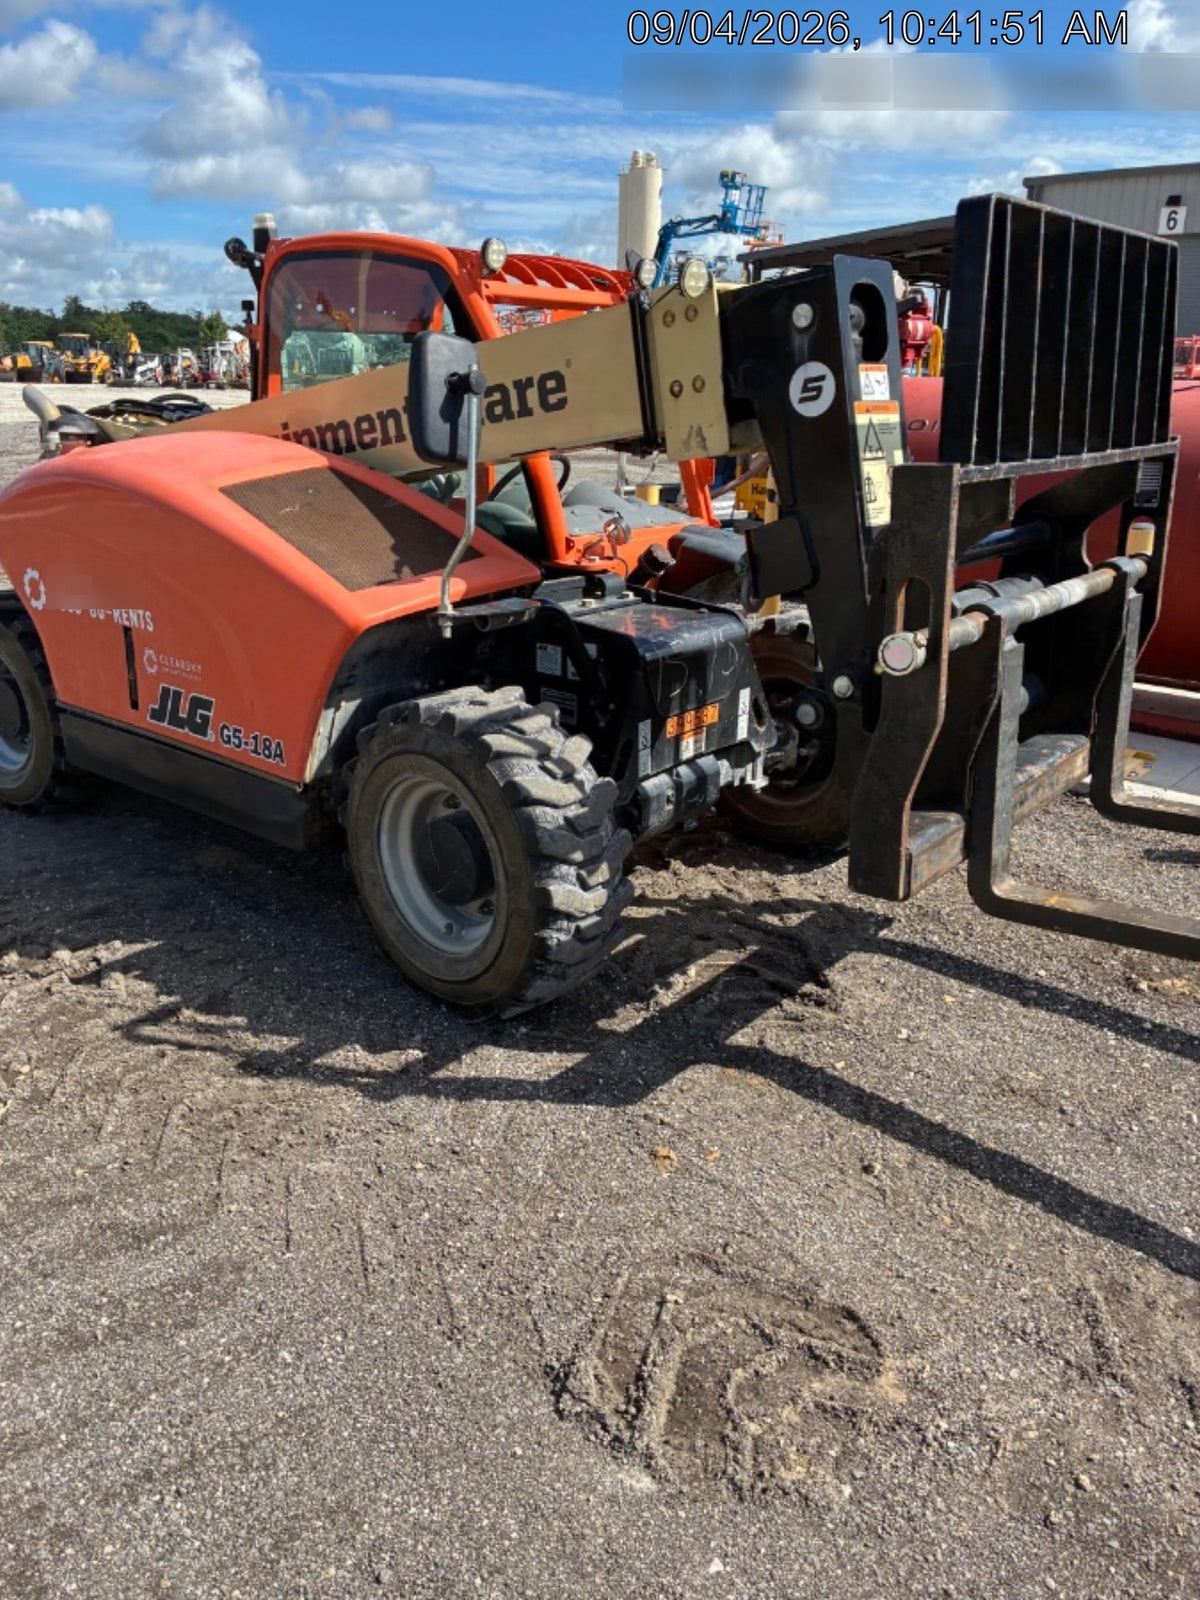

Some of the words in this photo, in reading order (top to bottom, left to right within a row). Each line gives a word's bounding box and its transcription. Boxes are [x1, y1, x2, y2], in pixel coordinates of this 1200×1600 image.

[1166, 209, 1178, 231] 6
[481, 370, 568, 425] are
[147, 683, 215, 741] JLG
[219, 721, 286, 766] G5-18A
